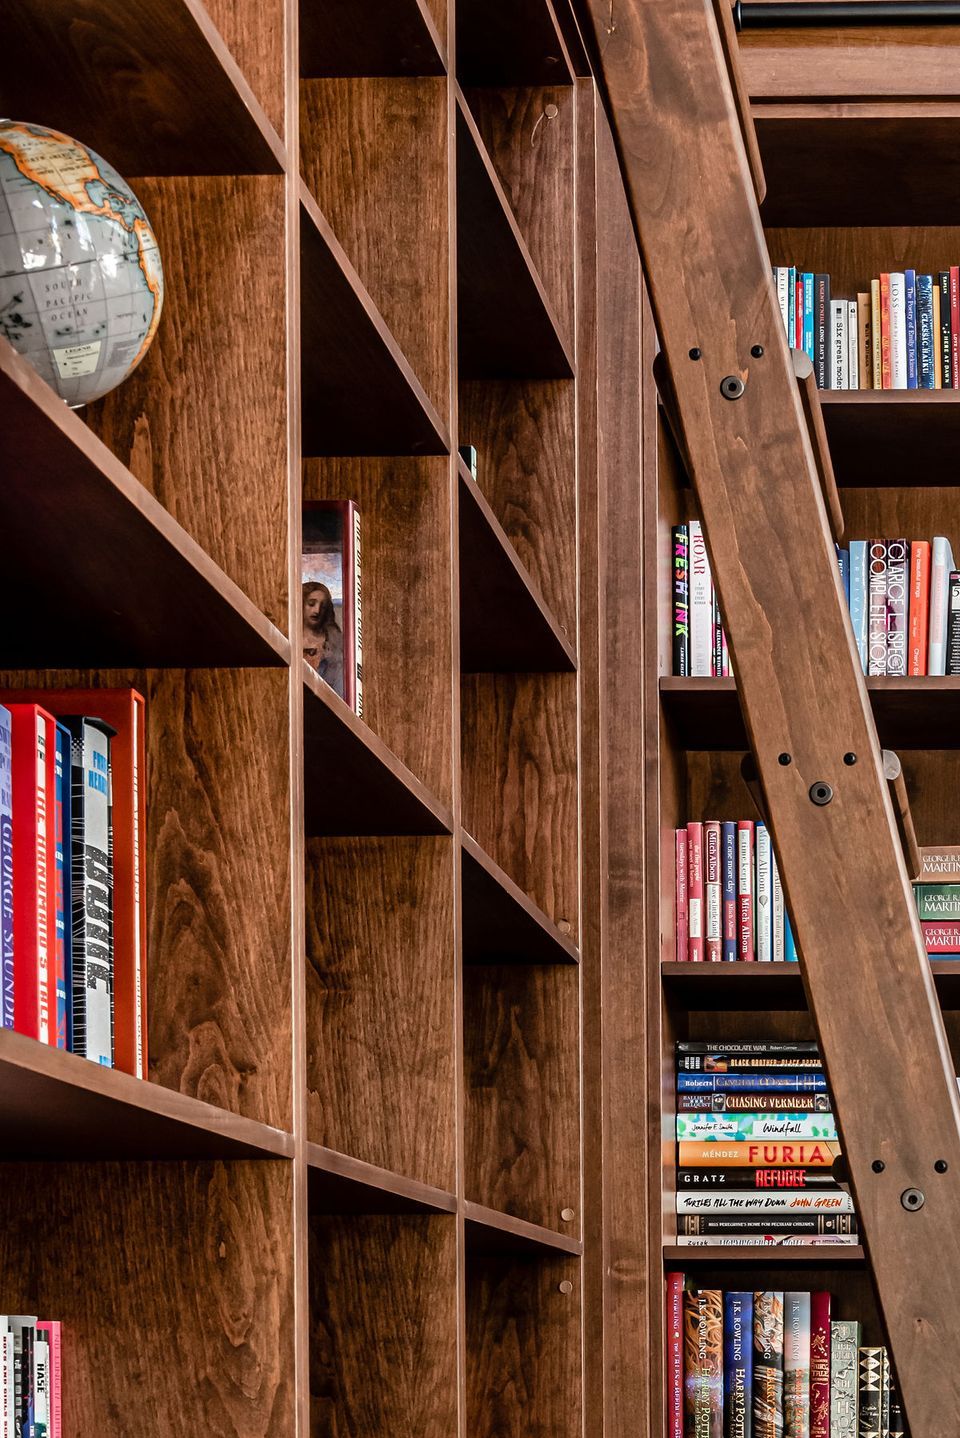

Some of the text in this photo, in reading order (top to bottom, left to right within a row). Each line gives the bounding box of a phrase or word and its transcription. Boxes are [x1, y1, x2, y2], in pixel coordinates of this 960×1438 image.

[44, 280, 82, 291] SOUTH
[45, 293, 92, 307] PACIFIC
[51, 309, 88, 321] OCEAN
[693, 535, 705, 575] ROAR
[676, 533, 688, 638] FRESH INK
[870, 544, 886, 625] COMPLETE
[887, 544, 904, 606] CLARICE
[1, 821, 13, 912] GEORGE
[726, 1095, 813, 1108] CHASING VERMEER
[763, 1123, 802, 1134] Windfall
[703, 1149, 739, 1158] MÉNDEZ
[749, 1146, 825, 1163] FURIA
[756, 1170, 806, 1187] REFUGEE
[684, 1198, 842, 1207] TURTLES ALL THE WAY DOWN JOHN GREEN
[36, 1363, 45, 1394] HASE
[701, 1369, 710, 1405] HARRY
[735, 1369, 745, 1405] HARRY
[766, 1368, 776, 1403] HARRY
